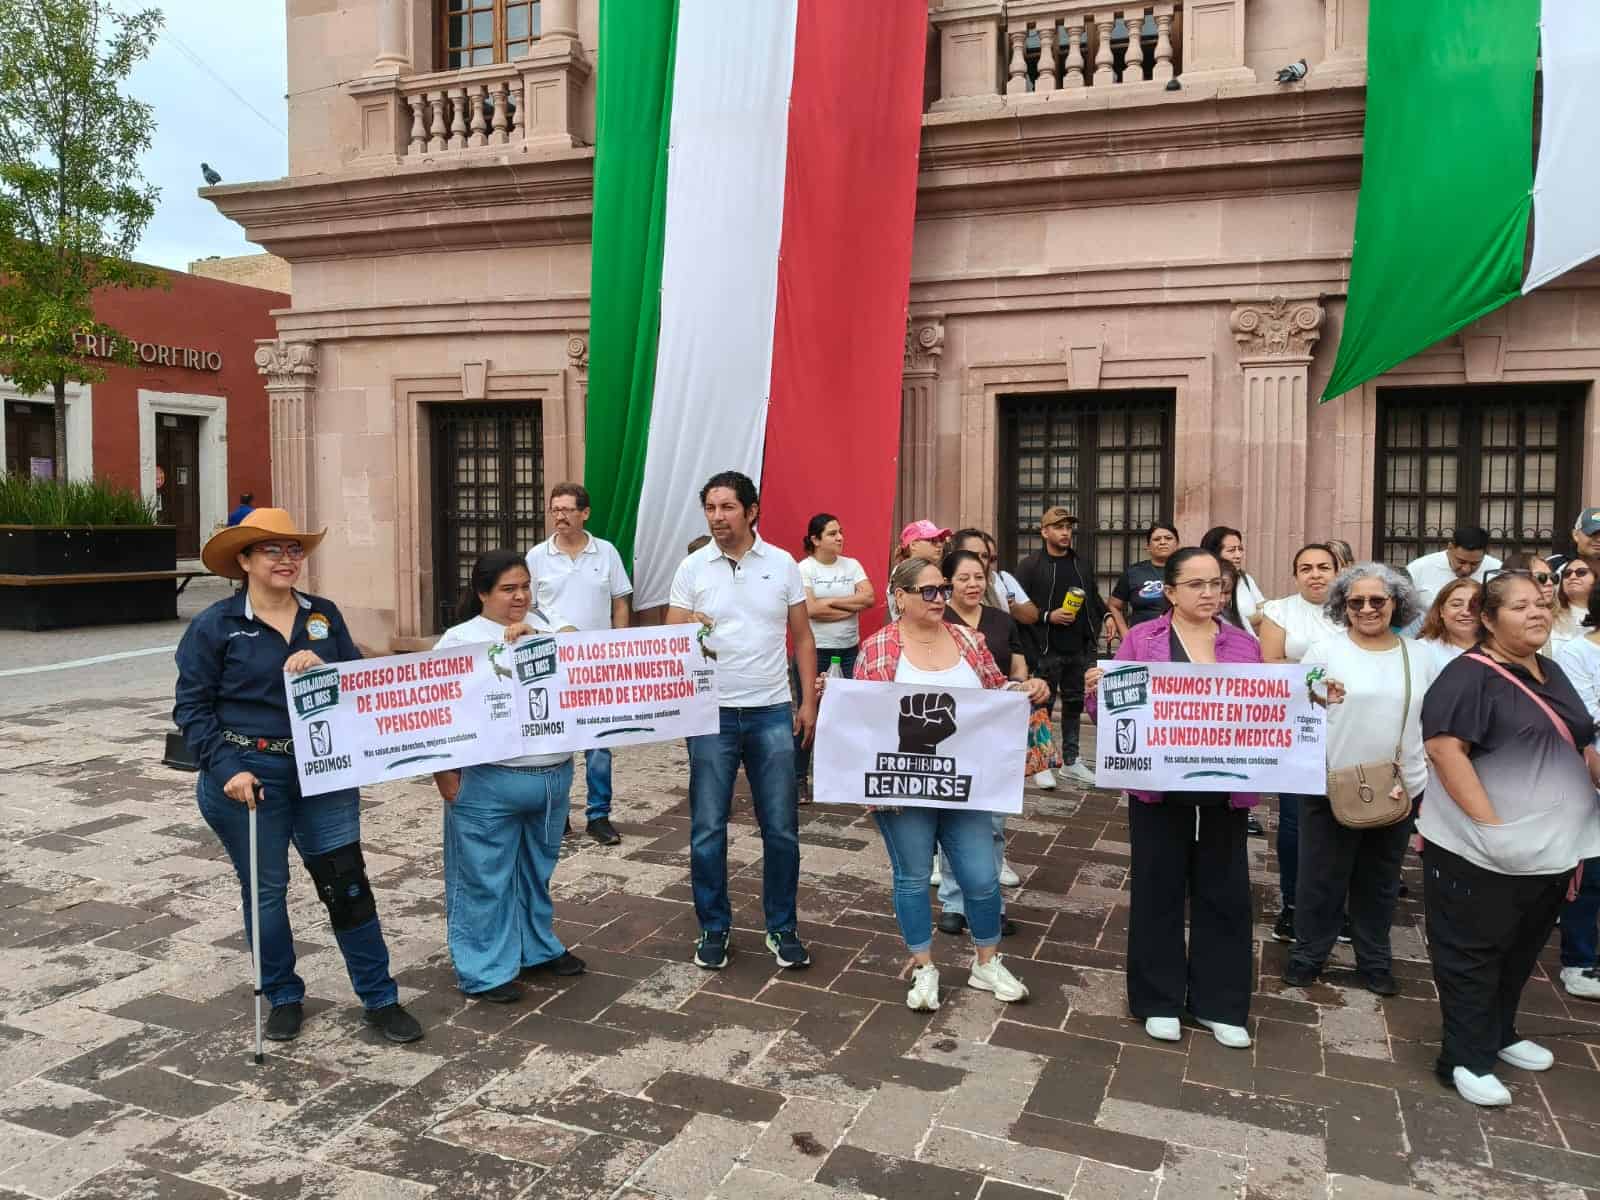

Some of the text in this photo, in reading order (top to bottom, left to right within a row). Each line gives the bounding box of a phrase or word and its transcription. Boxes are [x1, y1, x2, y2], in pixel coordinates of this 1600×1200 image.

[558, 636, 690, 662] NO A LOS ESTATUTOS QUE
[340, 656, 474, 692] REGRESO DEL RÉGIMEN
[568, 664, 633, 685] VIOLENTAN
[634, 659, 684, 680] NUESTRA
[356, 695, 372, 714] DE
[375, 681, 463, 711] JUBILACIONES
[559, 689, 614, 710] LIBERTAD
[616, 688, 630, 704] DE
[632, 679, 694, 702] EXPRESIÓN
[1151, 676, 1291, 698] INSUMOS Y PERSONAL
[376, 707, 452, 736] YPENSIONES
[1153, 703, 1224, 722] SUFICIENTE
[1226, 704, 1242, 722] EN
[1245, 704, 1286, 723] TODAS
[521, 720, 564, 737] ¡PEDIMOS!
[1146, 727, 1166, 746] LAS
[1170, 727, 1232, 748] UNIDADES
[1234, 728, 1292, 749] MEDICAS
[304, 754, 352, 776] ¡PEDIMOS!
[879, 756, 953, 772] PROHIBIDO
[1104, 756, 1152, 771] ¡PEDIMOS!
[868, 776, 967, 798] RENDIRSE
